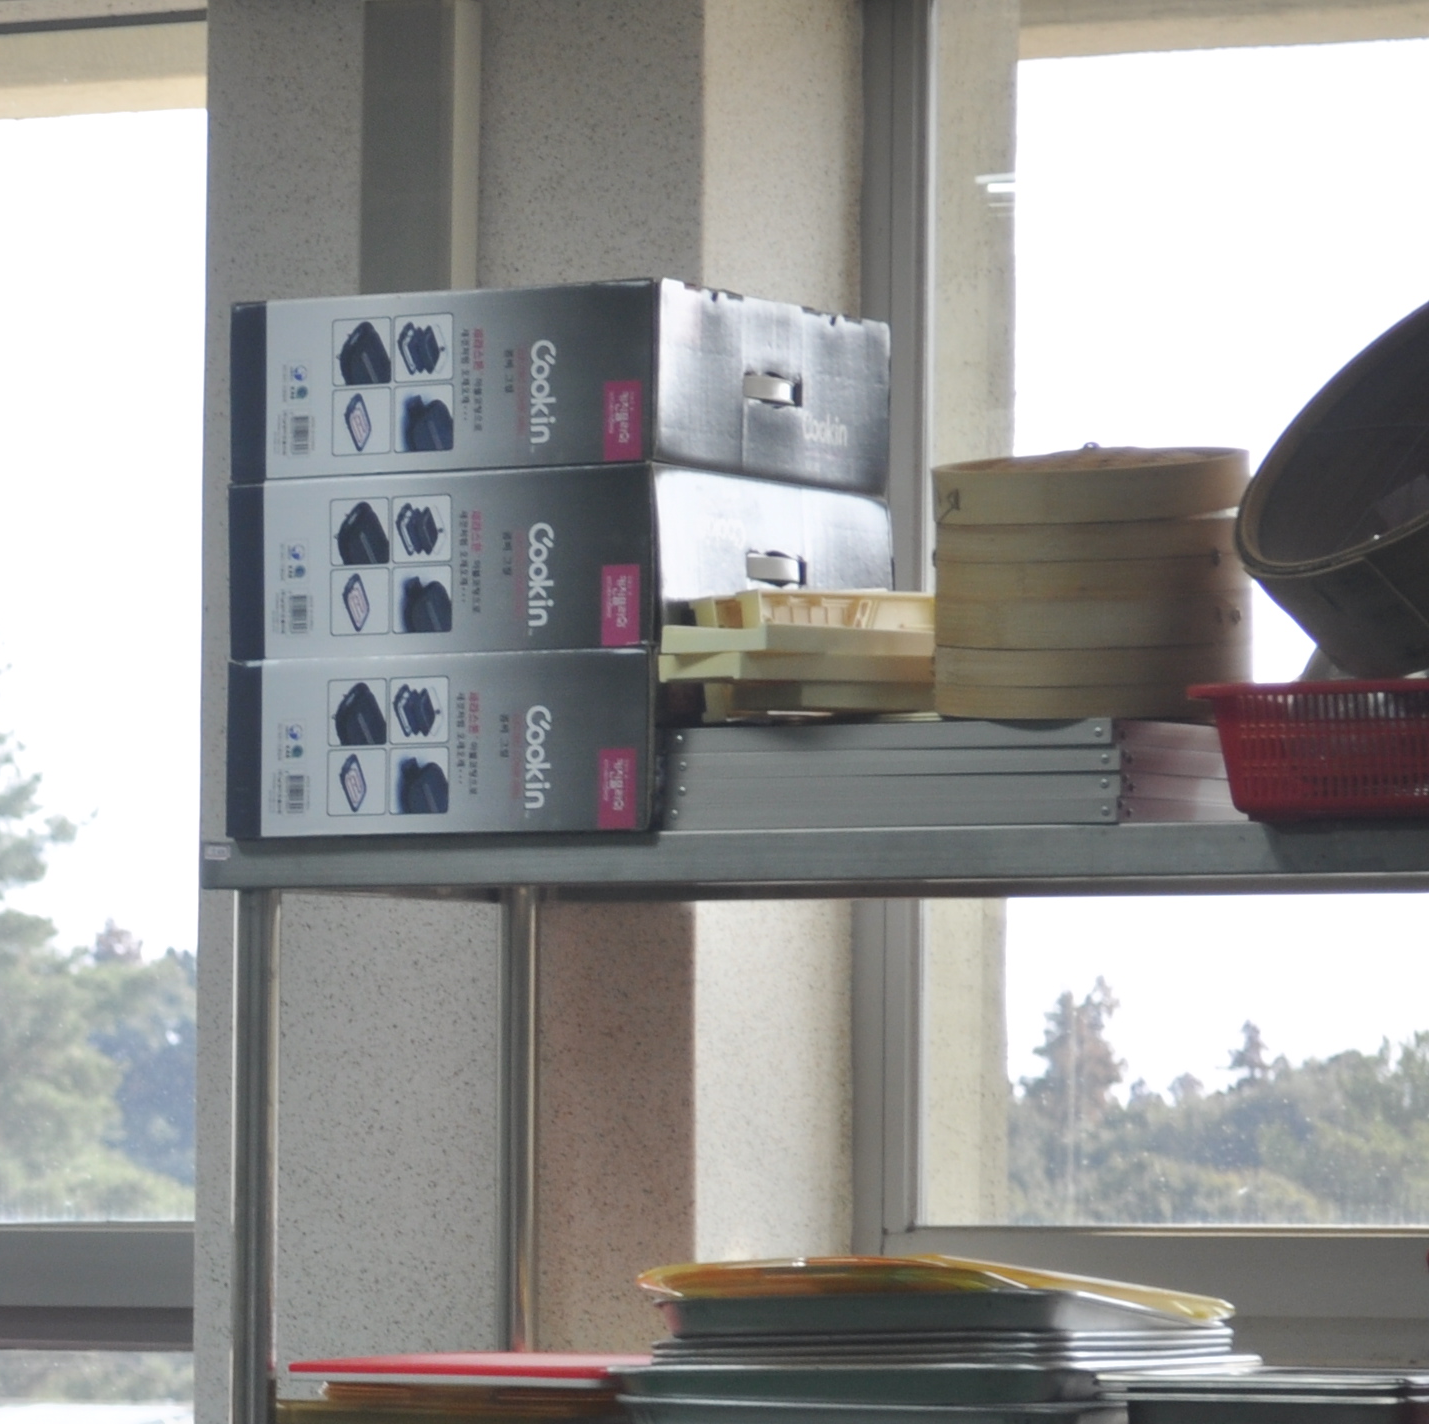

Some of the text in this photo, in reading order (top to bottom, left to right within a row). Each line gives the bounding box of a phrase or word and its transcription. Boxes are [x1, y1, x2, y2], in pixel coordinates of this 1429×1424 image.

[530, 339, 557, 444] Cookin
[802, 412, 848, 447] Cookin
[528, 522, 555, 627] Cookin
[525, 705, 552, 809] Cookin
